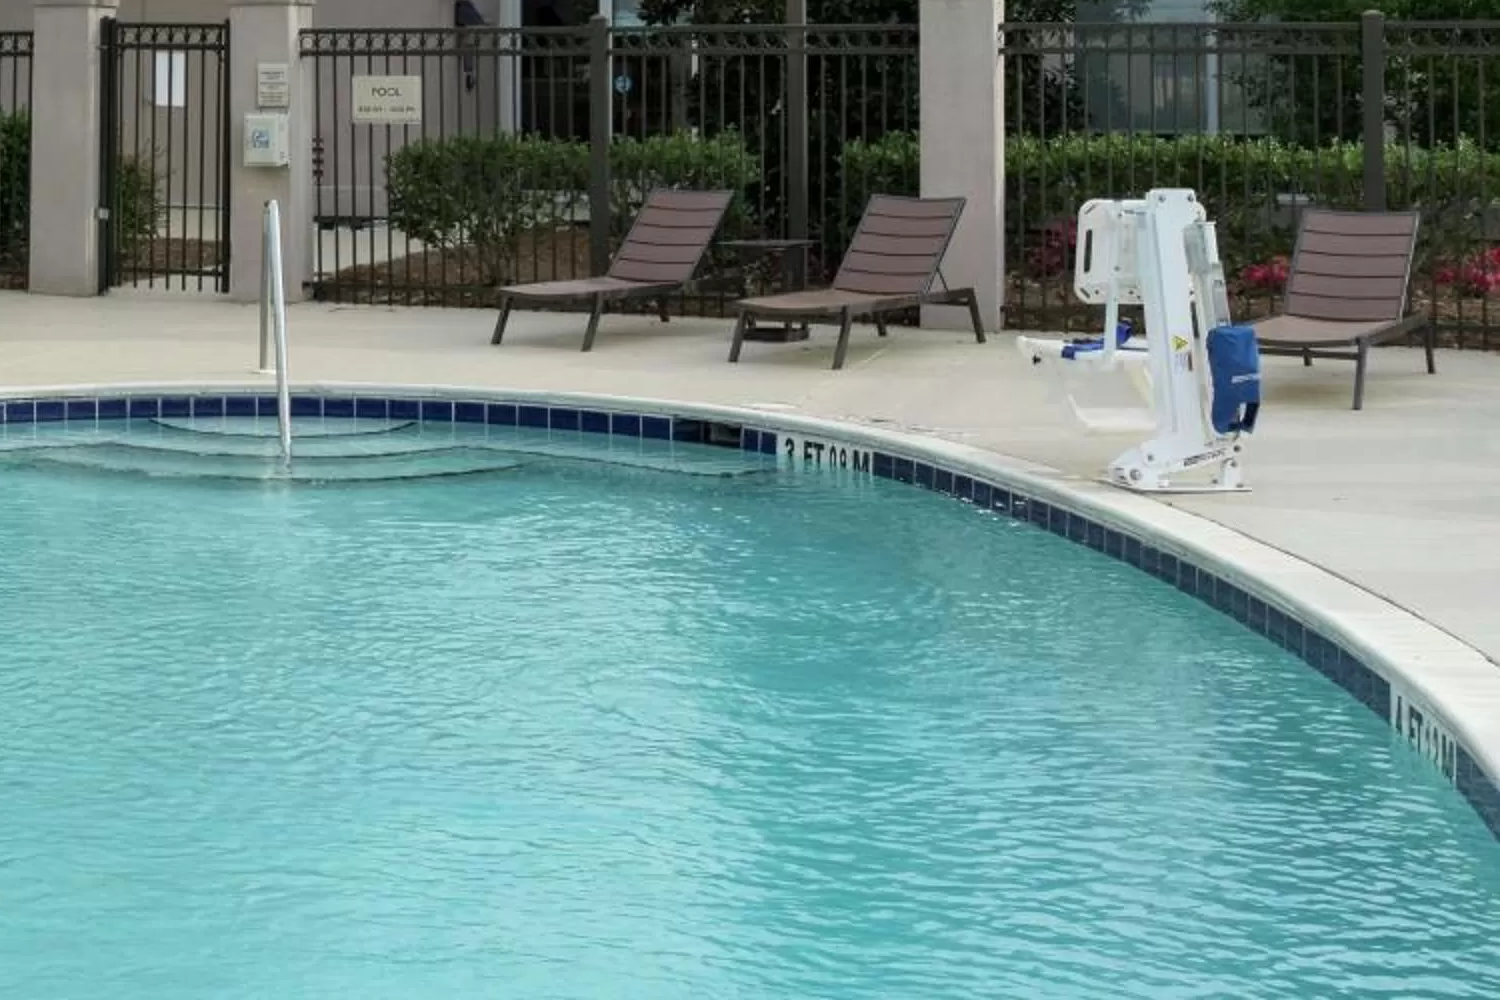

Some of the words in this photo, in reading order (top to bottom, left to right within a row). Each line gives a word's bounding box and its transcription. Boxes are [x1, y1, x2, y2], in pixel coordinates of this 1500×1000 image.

[371, 87, 403, 97] POOL
[803, 440, 825, 463] FT
[853, 449, 870, 473] M
